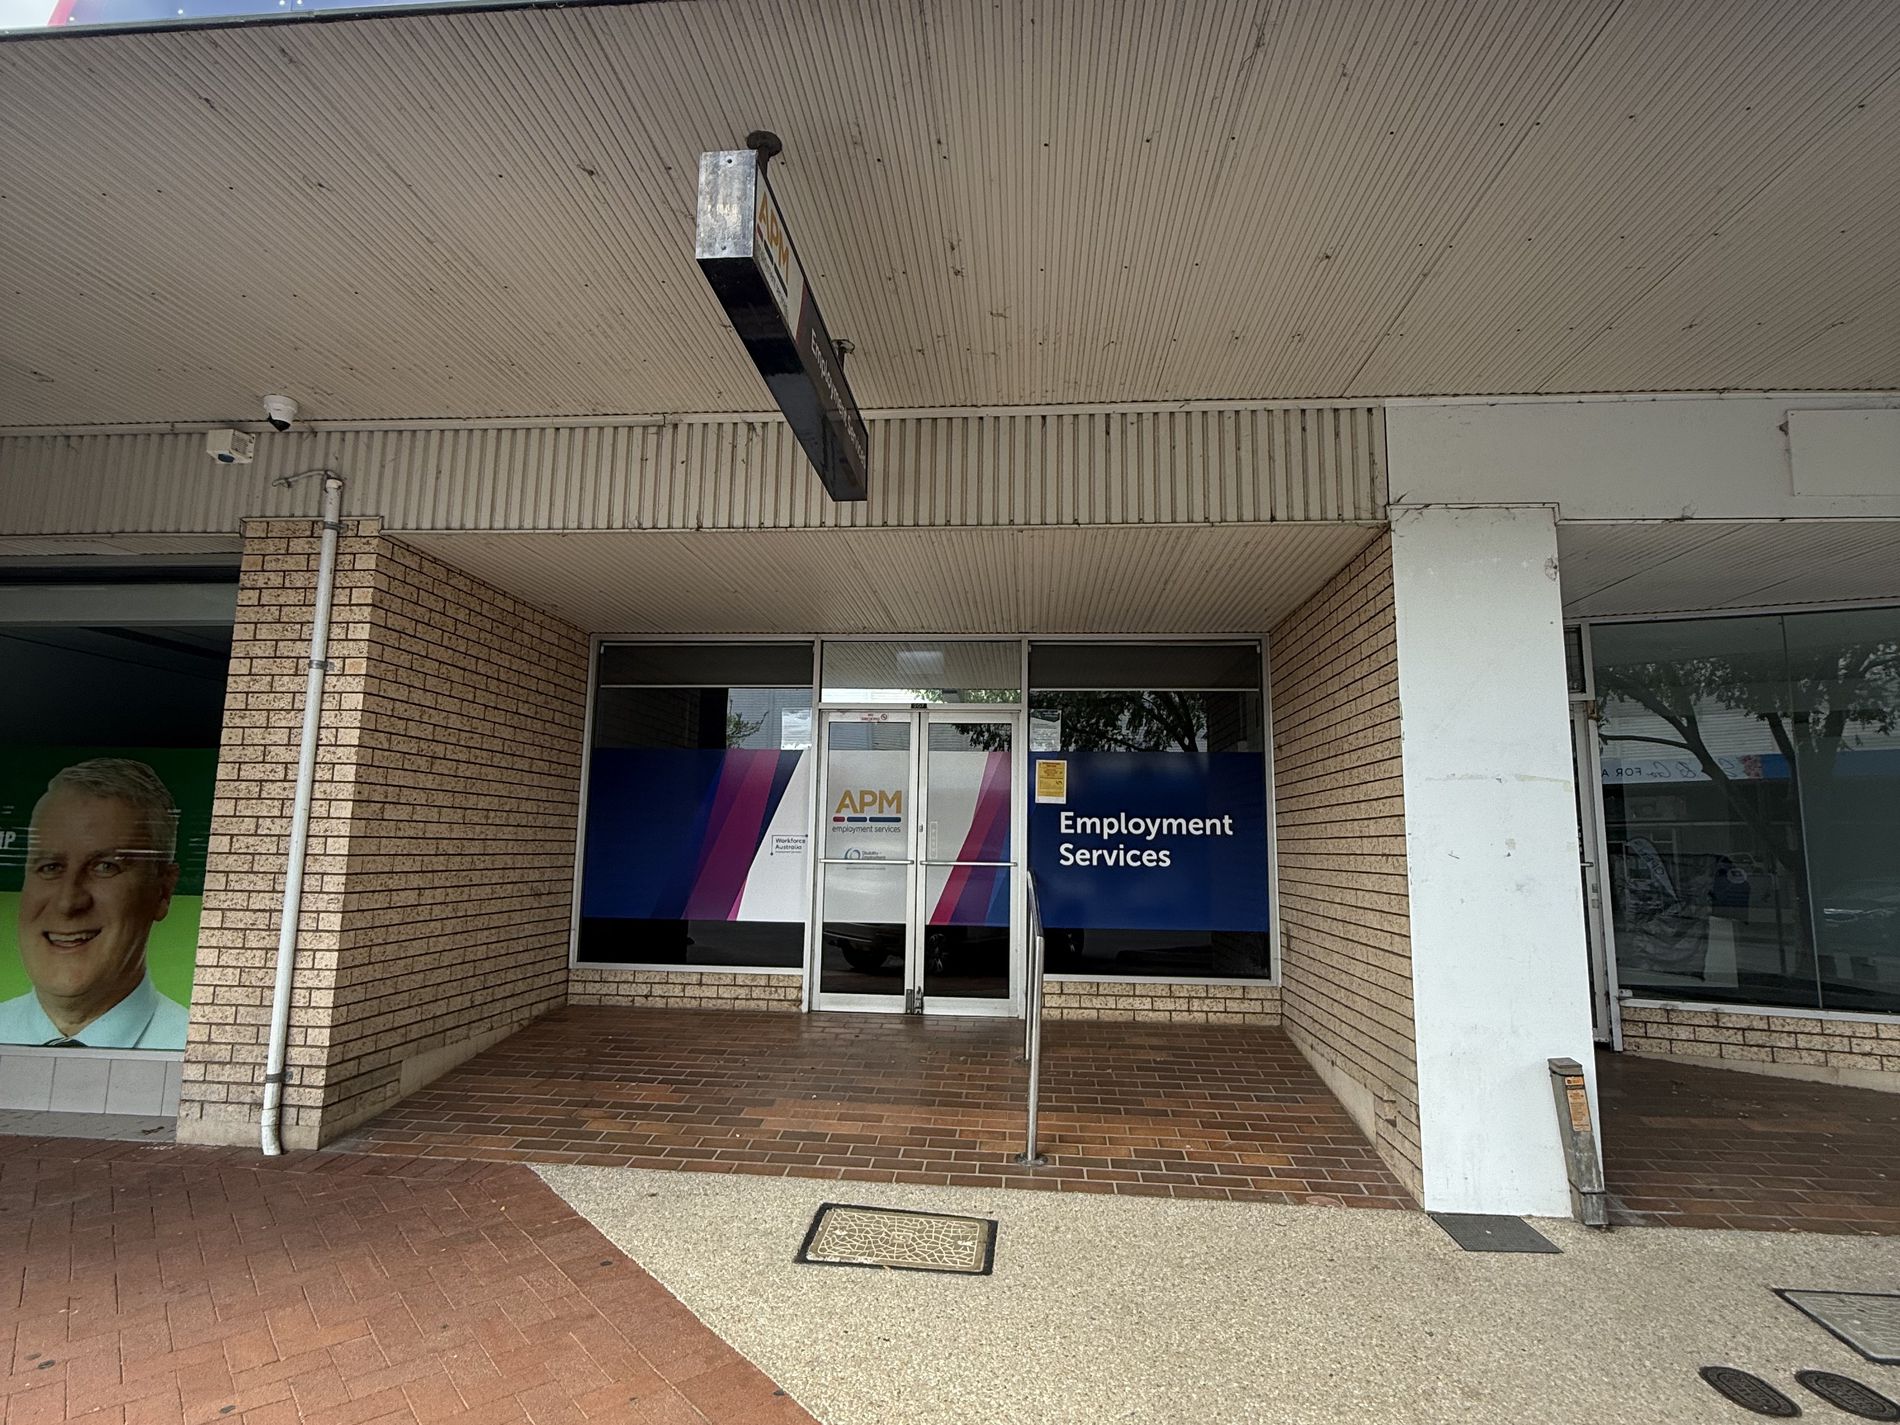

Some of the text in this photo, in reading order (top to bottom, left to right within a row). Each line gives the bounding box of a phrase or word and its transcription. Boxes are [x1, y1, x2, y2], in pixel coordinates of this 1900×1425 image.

[758, 191, 787, 284] APM
[811, 327, 848, 426] Employment
[835, 790, 902, 814] APM
[832, 825, 901, 834] employment services
[1060, 811, 1233, 840] Employment
[1059, 843, 1171, 867] Services
